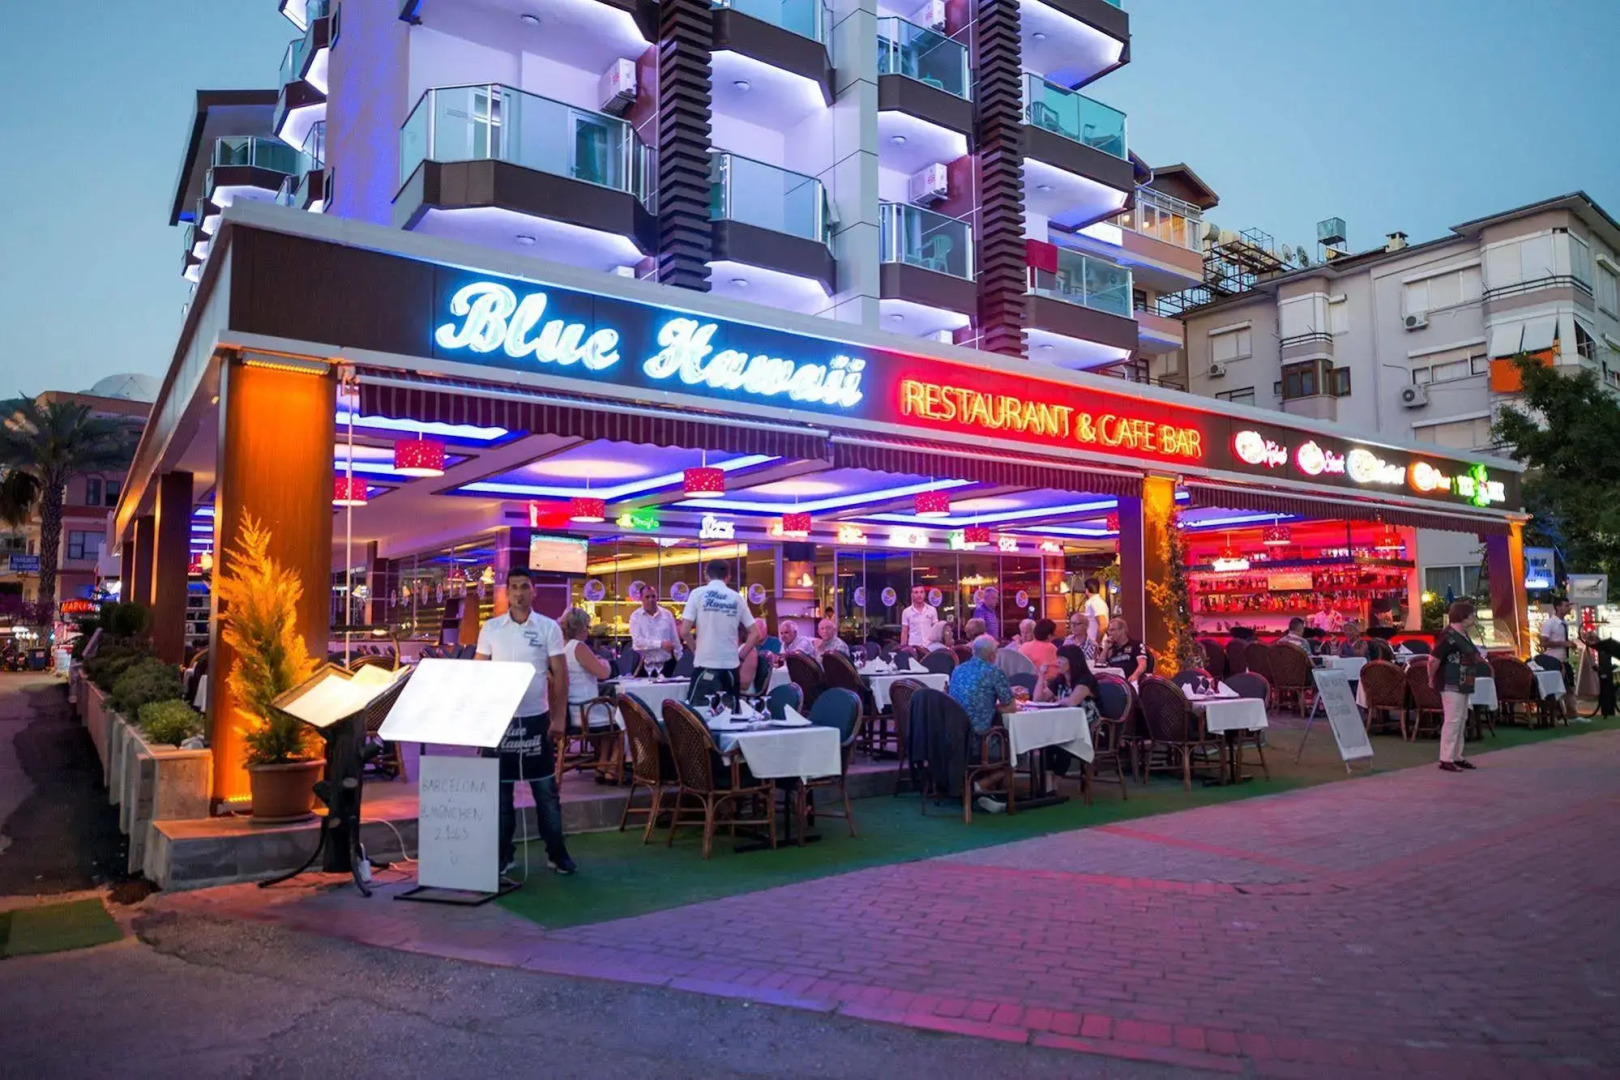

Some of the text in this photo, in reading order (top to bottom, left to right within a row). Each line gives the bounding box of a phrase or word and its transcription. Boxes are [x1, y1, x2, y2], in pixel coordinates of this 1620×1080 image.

[434, 281, 867, 408] Blue Hawaii
[901, 379, 1202, 458] RESTAURANT & CAFE BAR
[421, 778, 487, 793] BARCELONA
